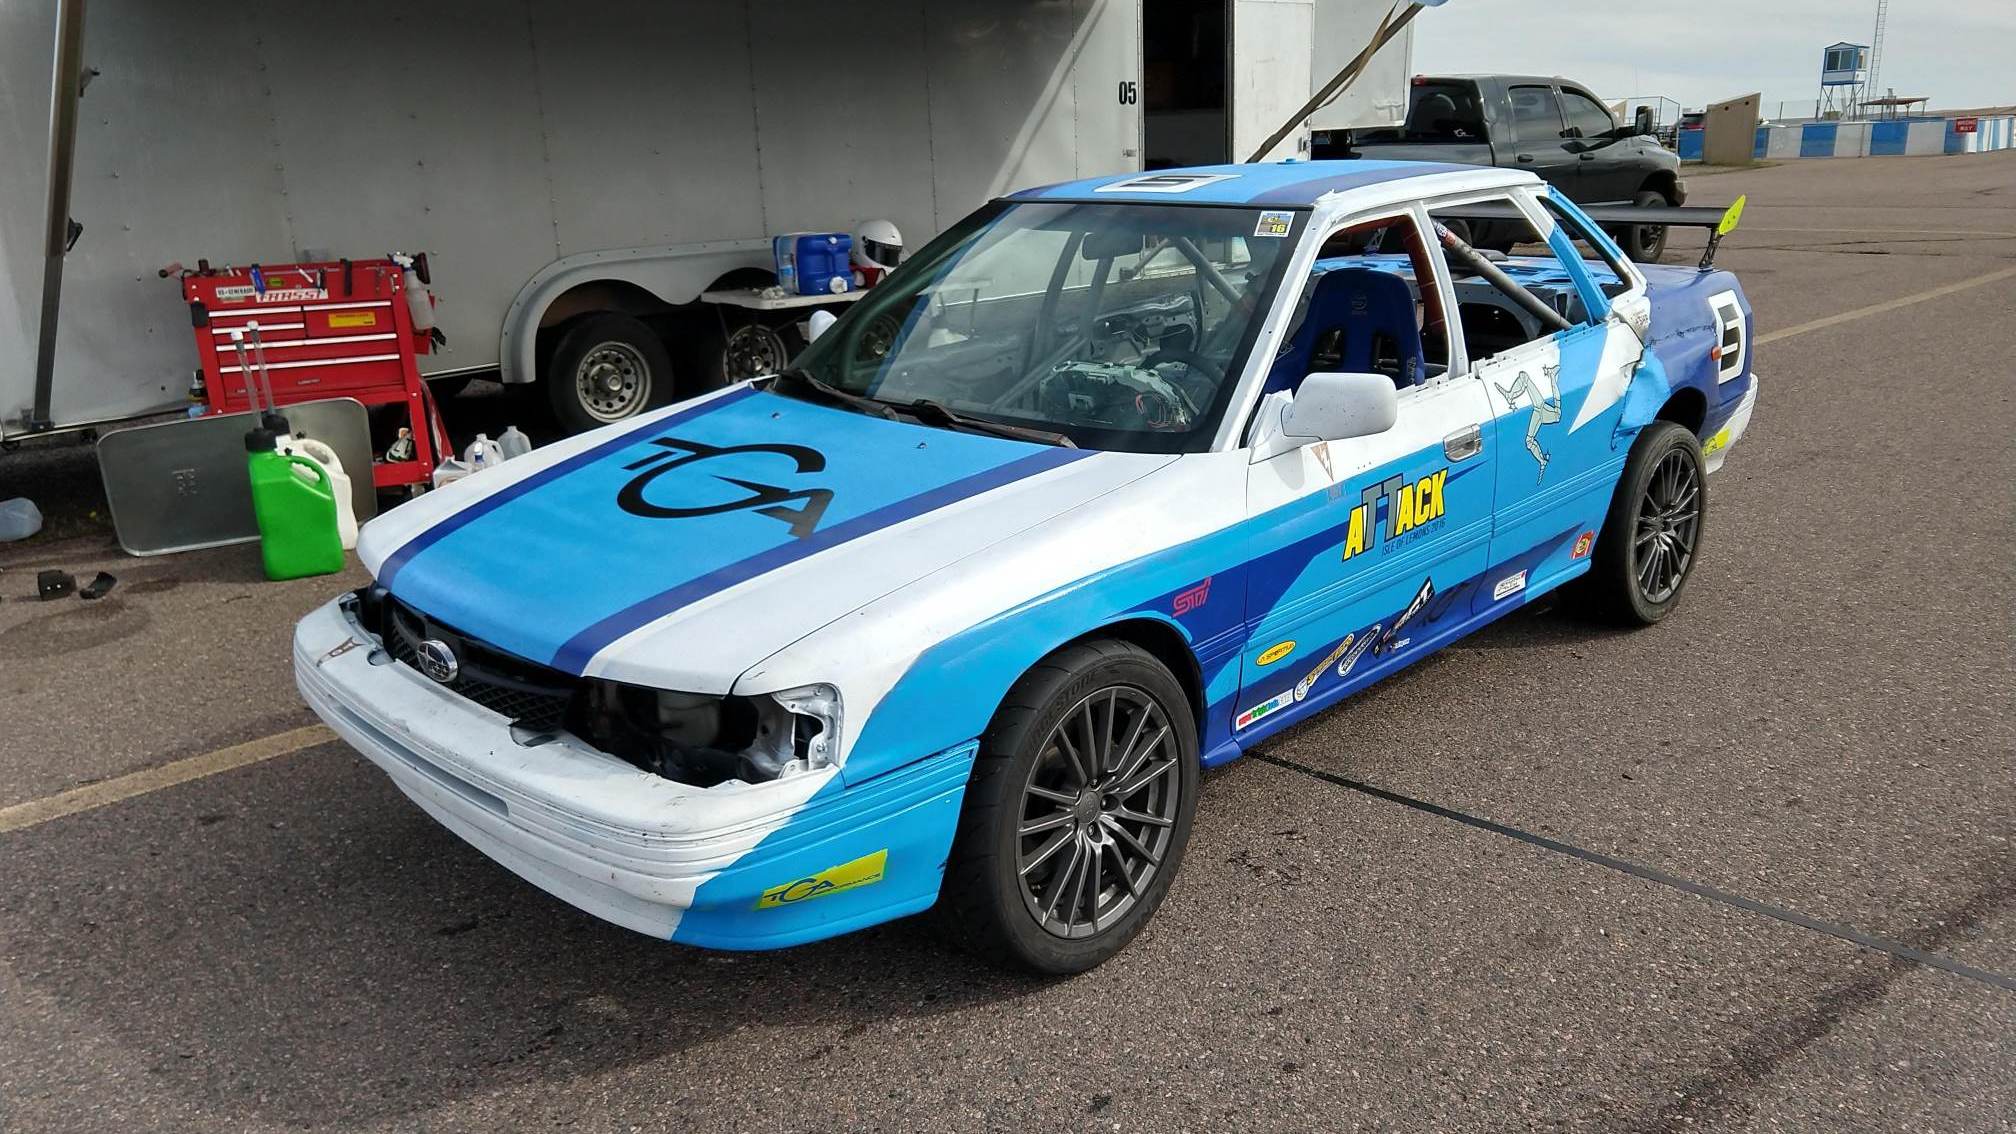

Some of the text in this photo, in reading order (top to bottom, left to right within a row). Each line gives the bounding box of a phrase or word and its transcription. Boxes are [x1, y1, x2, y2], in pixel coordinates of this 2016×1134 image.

[1118, 81, 1137, 105] 05
[1342, 467, 1449, 562] ATTACK
[1382, 541, 1396, 556] ISLE
[1396, 536, 1405, 549] OF
